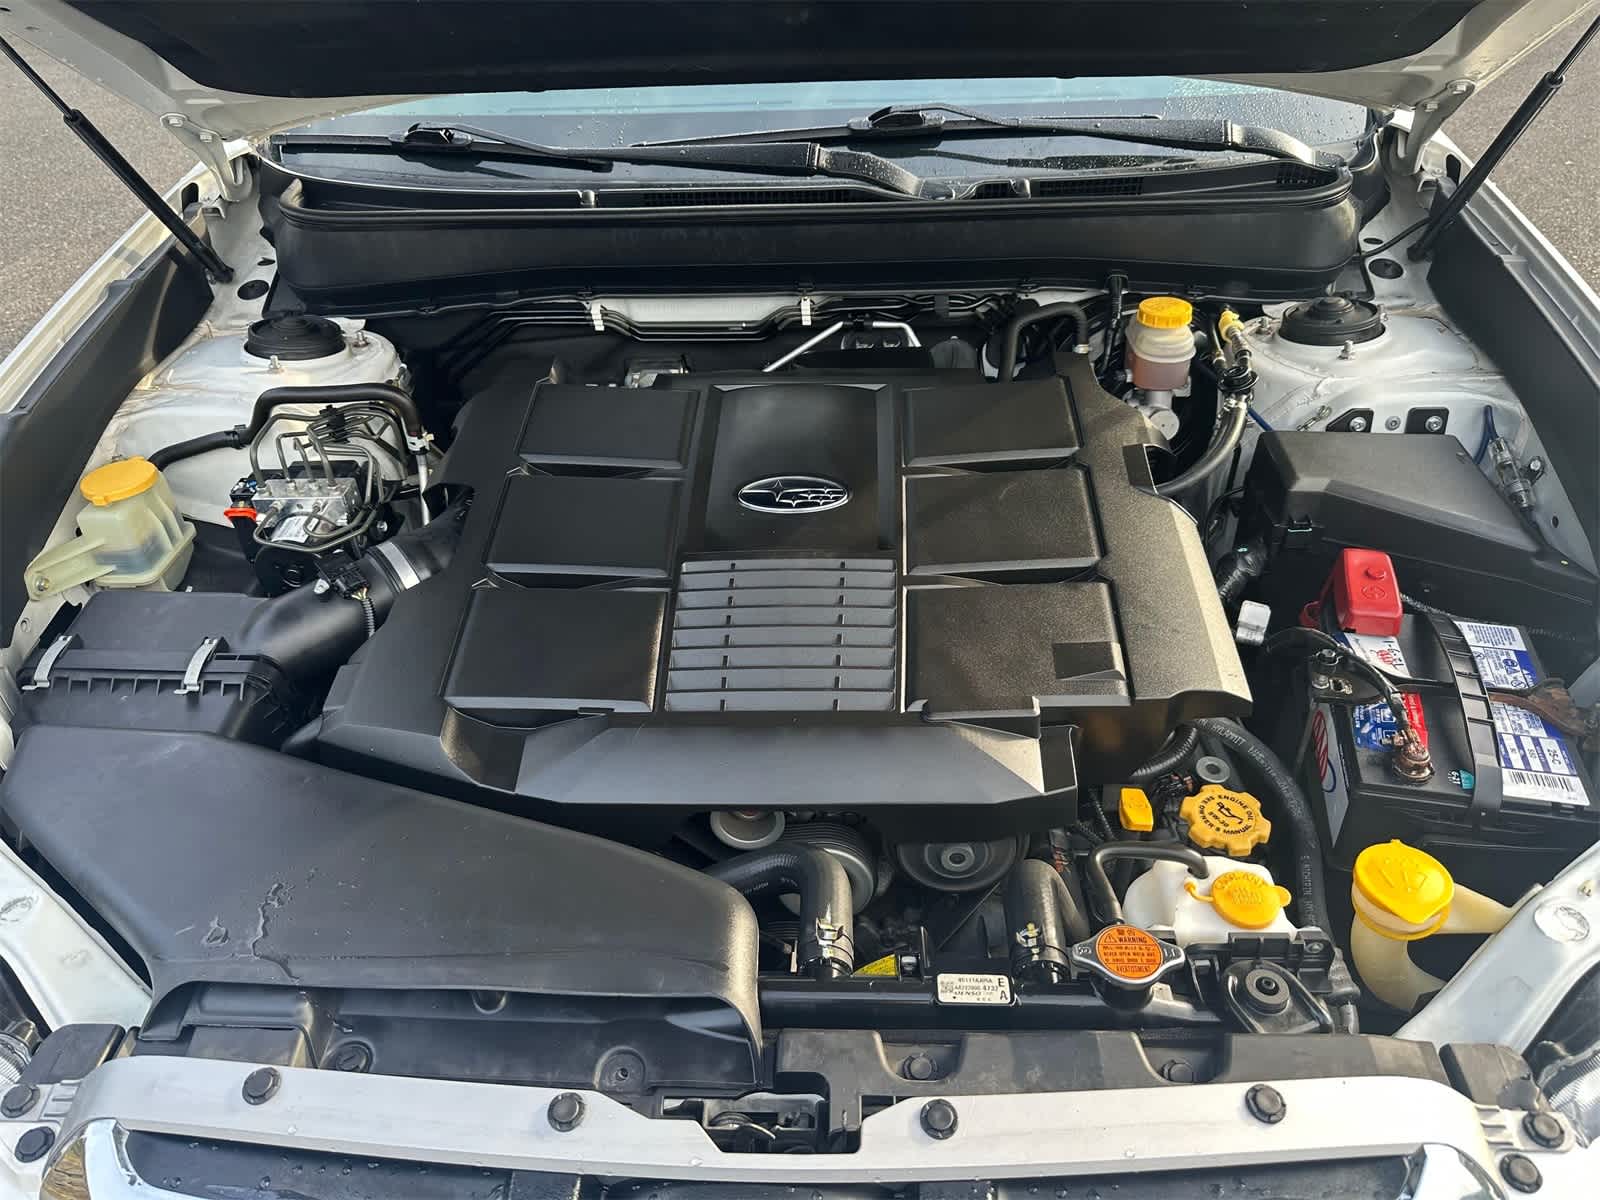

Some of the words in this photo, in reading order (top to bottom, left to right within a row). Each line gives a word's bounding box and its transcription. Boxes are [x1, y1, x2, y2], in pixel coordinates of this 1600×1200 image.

[1202, 795, 1215, 805] SEE
[1223, 824, 1252, 835] MANUAL
[1217, 794, 1249, 810] ENGINE
[1246, 810, 1255, 821] OIL
[1208, 811, 1229, 827] 5W-30
[998, 977, 1005, 987] E
[1000, 990, 1008, 1000] A
